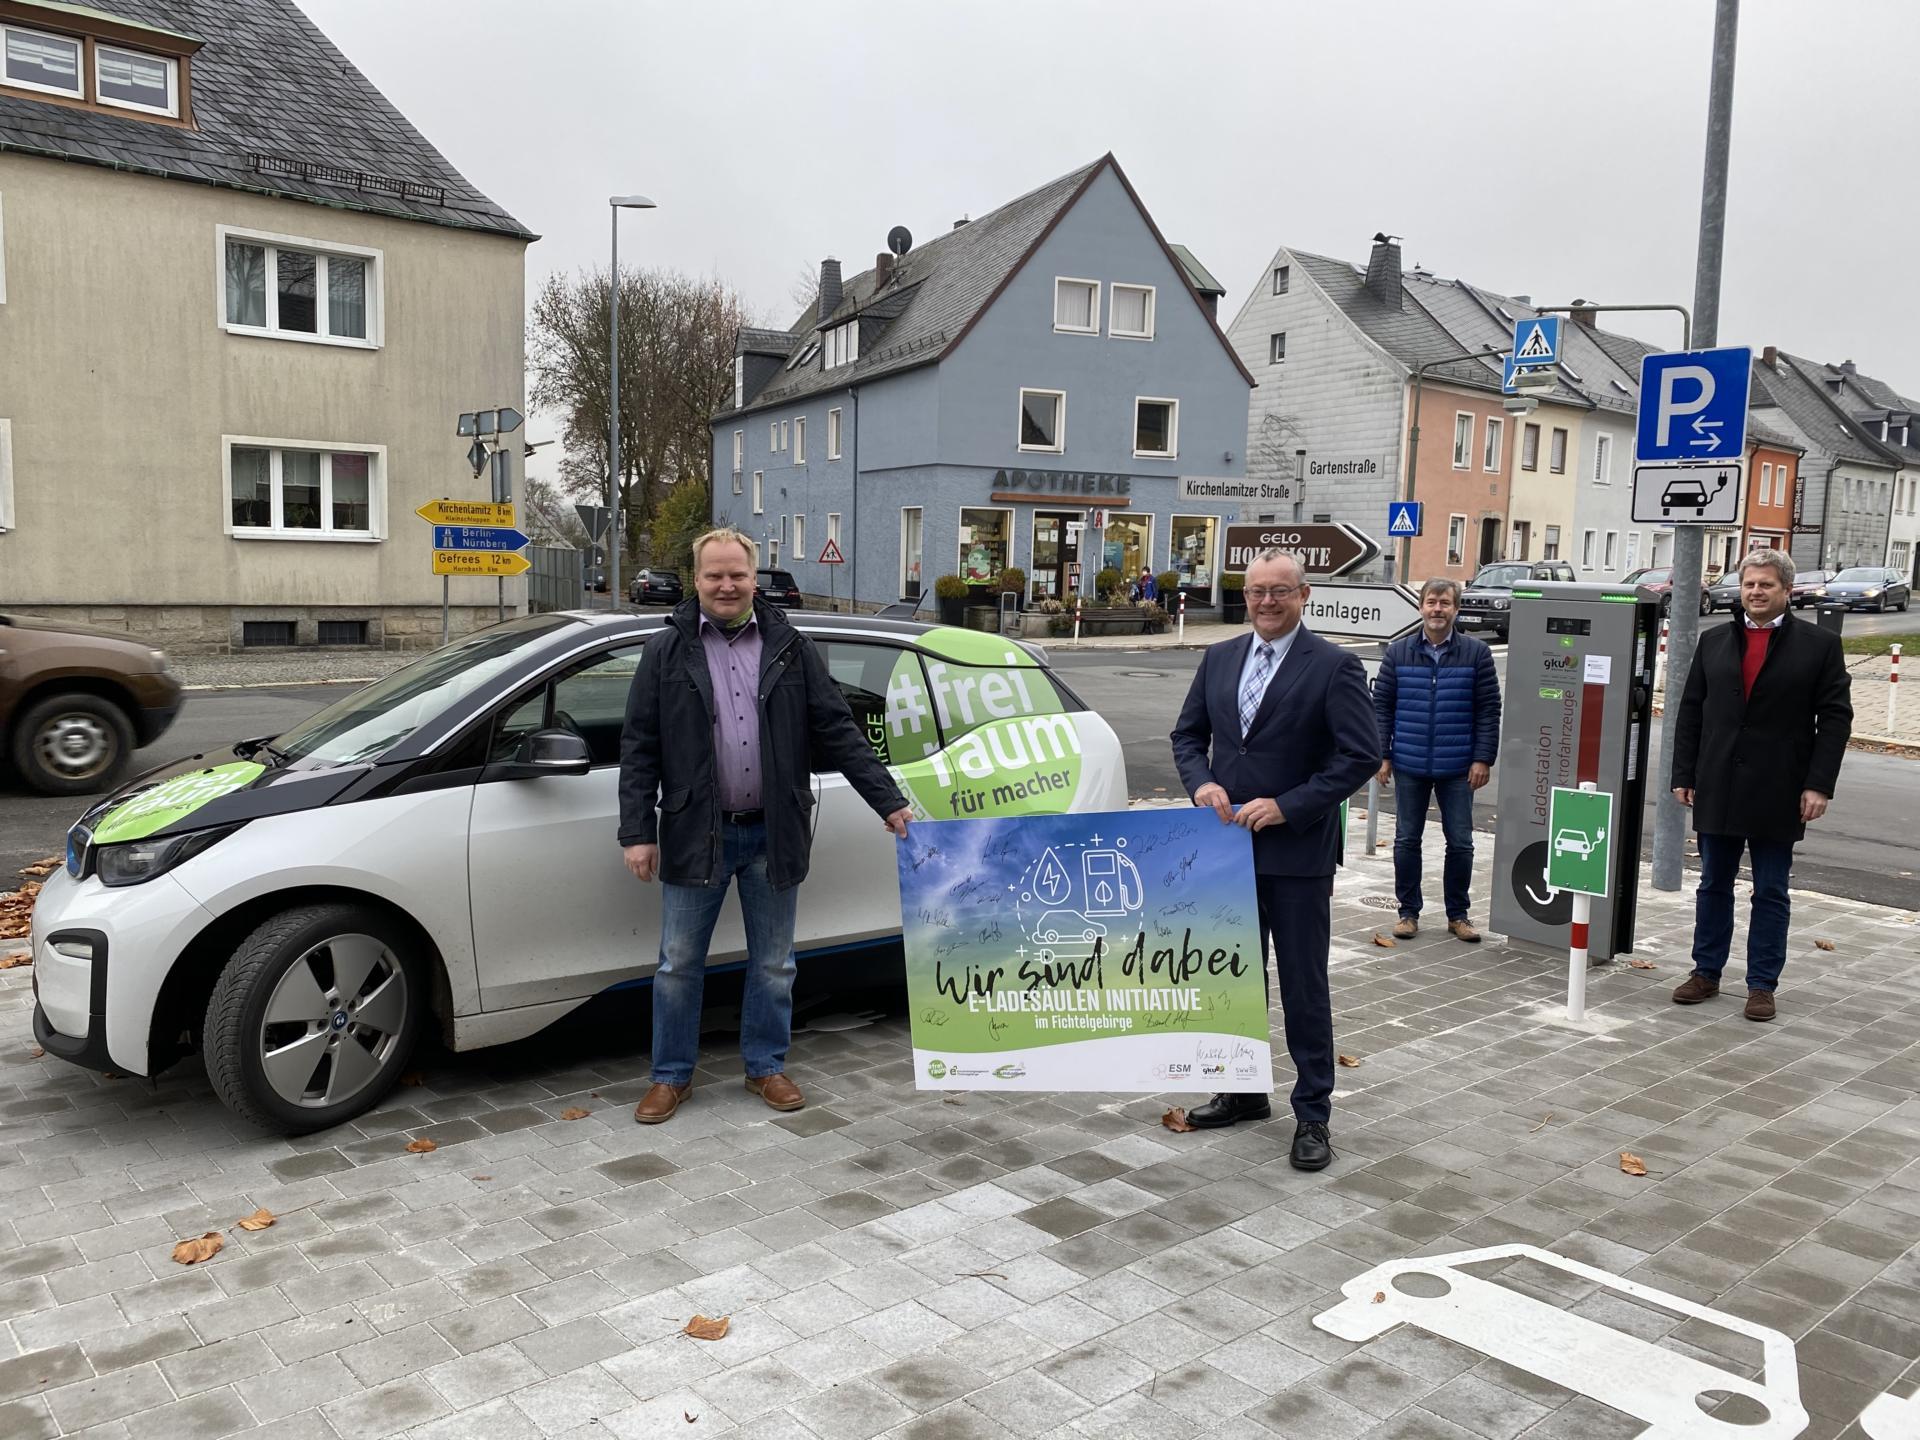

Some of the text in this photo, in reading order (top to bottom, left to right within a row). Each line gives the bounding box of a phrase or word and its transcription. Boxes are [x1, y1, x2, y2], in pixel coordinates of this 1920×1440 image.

[1656, 366, 1716, 447] P
[1310, 459, 1376, 475] Gartenstraße
[992, 469, 1131, 494] APOTHEKE
[1187, 481, 1290, 499] Kirchenlamitzer Straße
[438, 503, 491, 515] Kirchenlamitz
[503, 507, 511, 515] km
[462, 529, 495, 538] Berlin-
[462, 538, 507, 549] Nürnberg
[1260, 533, 1301, 544] GELO
[438, 553, 511, 565] Gefrees 12 km
[1229, 546, 1331, 566] HOSTE
[1302, 600, 1381, 624] rtanlagen
[1544, 658, 1565, 670] gku
[885, 652, 1035, 738] #frei
[1555, 689, 1578, 788] ktrofahrzeuge
[923, 714, 1082, 788] raum
[1530, 725, 1553, 826] Ladestation
[950, 769, 1071, 817] für macher
[936, 928, 1248, 1005] Wir sind dabei
[968, 985, 1203, 1013] E-LADESÄULEN INITIATIVE
[1035, 1015, 1050, 1029] im
[1053, 1014, 1133, 1031] Fichtelgebirge
[1169, 1064, 1191, 1073] ESM
